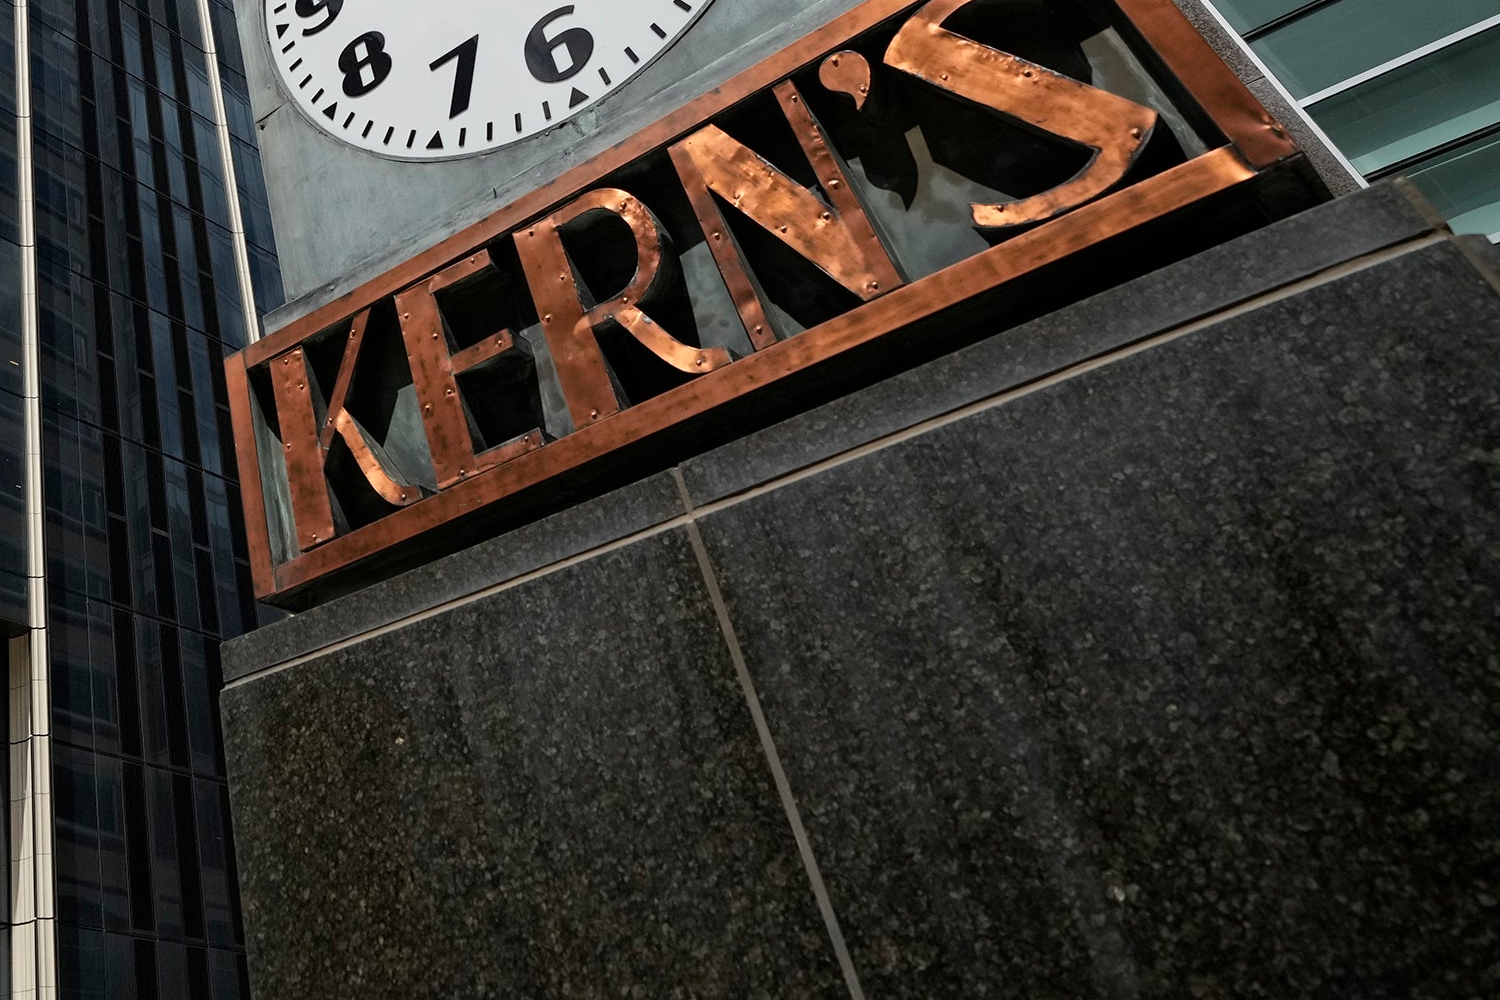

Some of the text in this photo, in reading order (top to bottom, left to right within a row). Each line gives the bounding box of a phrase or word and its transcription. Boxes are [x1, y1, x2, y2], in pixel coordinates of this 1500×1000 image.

[337, 30, 393, 98] 8
[428, 33, 479, 120] 7
[524, 4, 594, 84] 6
